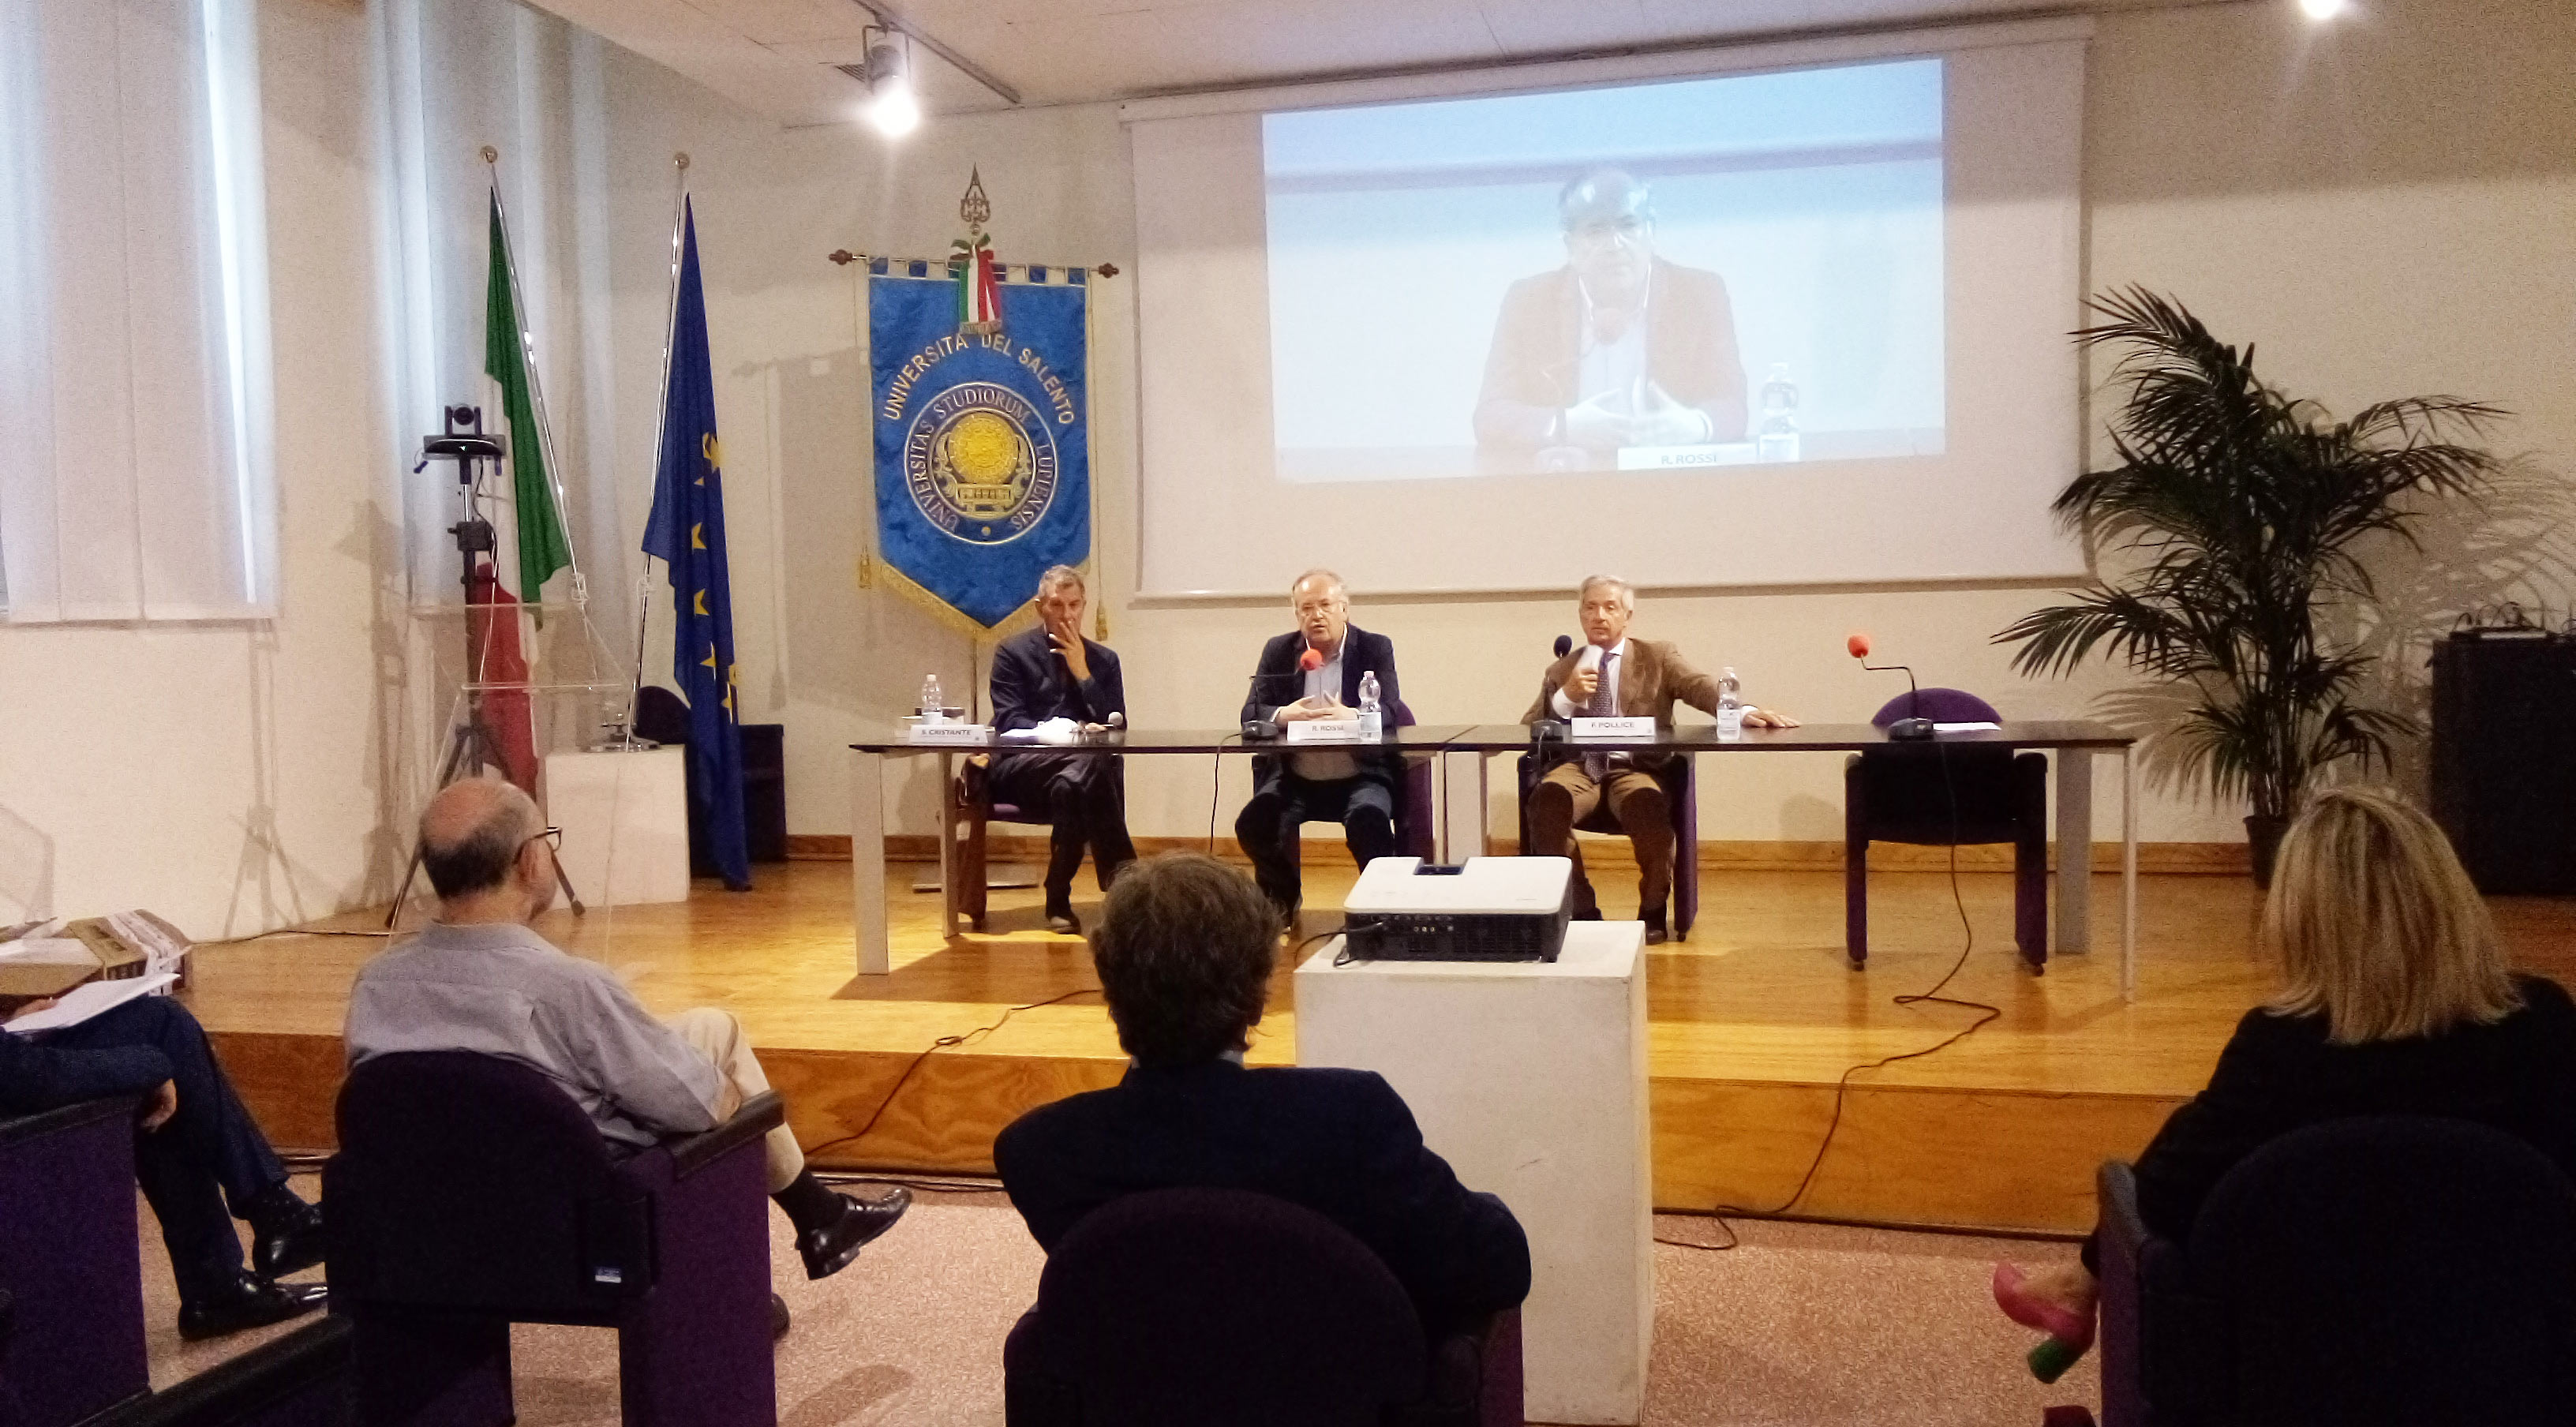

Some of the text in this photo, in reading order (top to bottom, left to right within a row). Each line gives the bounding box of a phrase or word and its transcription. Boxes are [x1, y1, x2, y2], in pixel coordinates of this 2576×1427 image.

[981, 333, 1013, 357] DEL
[1019, 348, 1075, 424] SALENTO
[908, 420, 960, 533] UNIVERSITAS
[934, 388, 1032, 424] STUDIORUM
[1676, 453, 1717, 464] ROSSI
